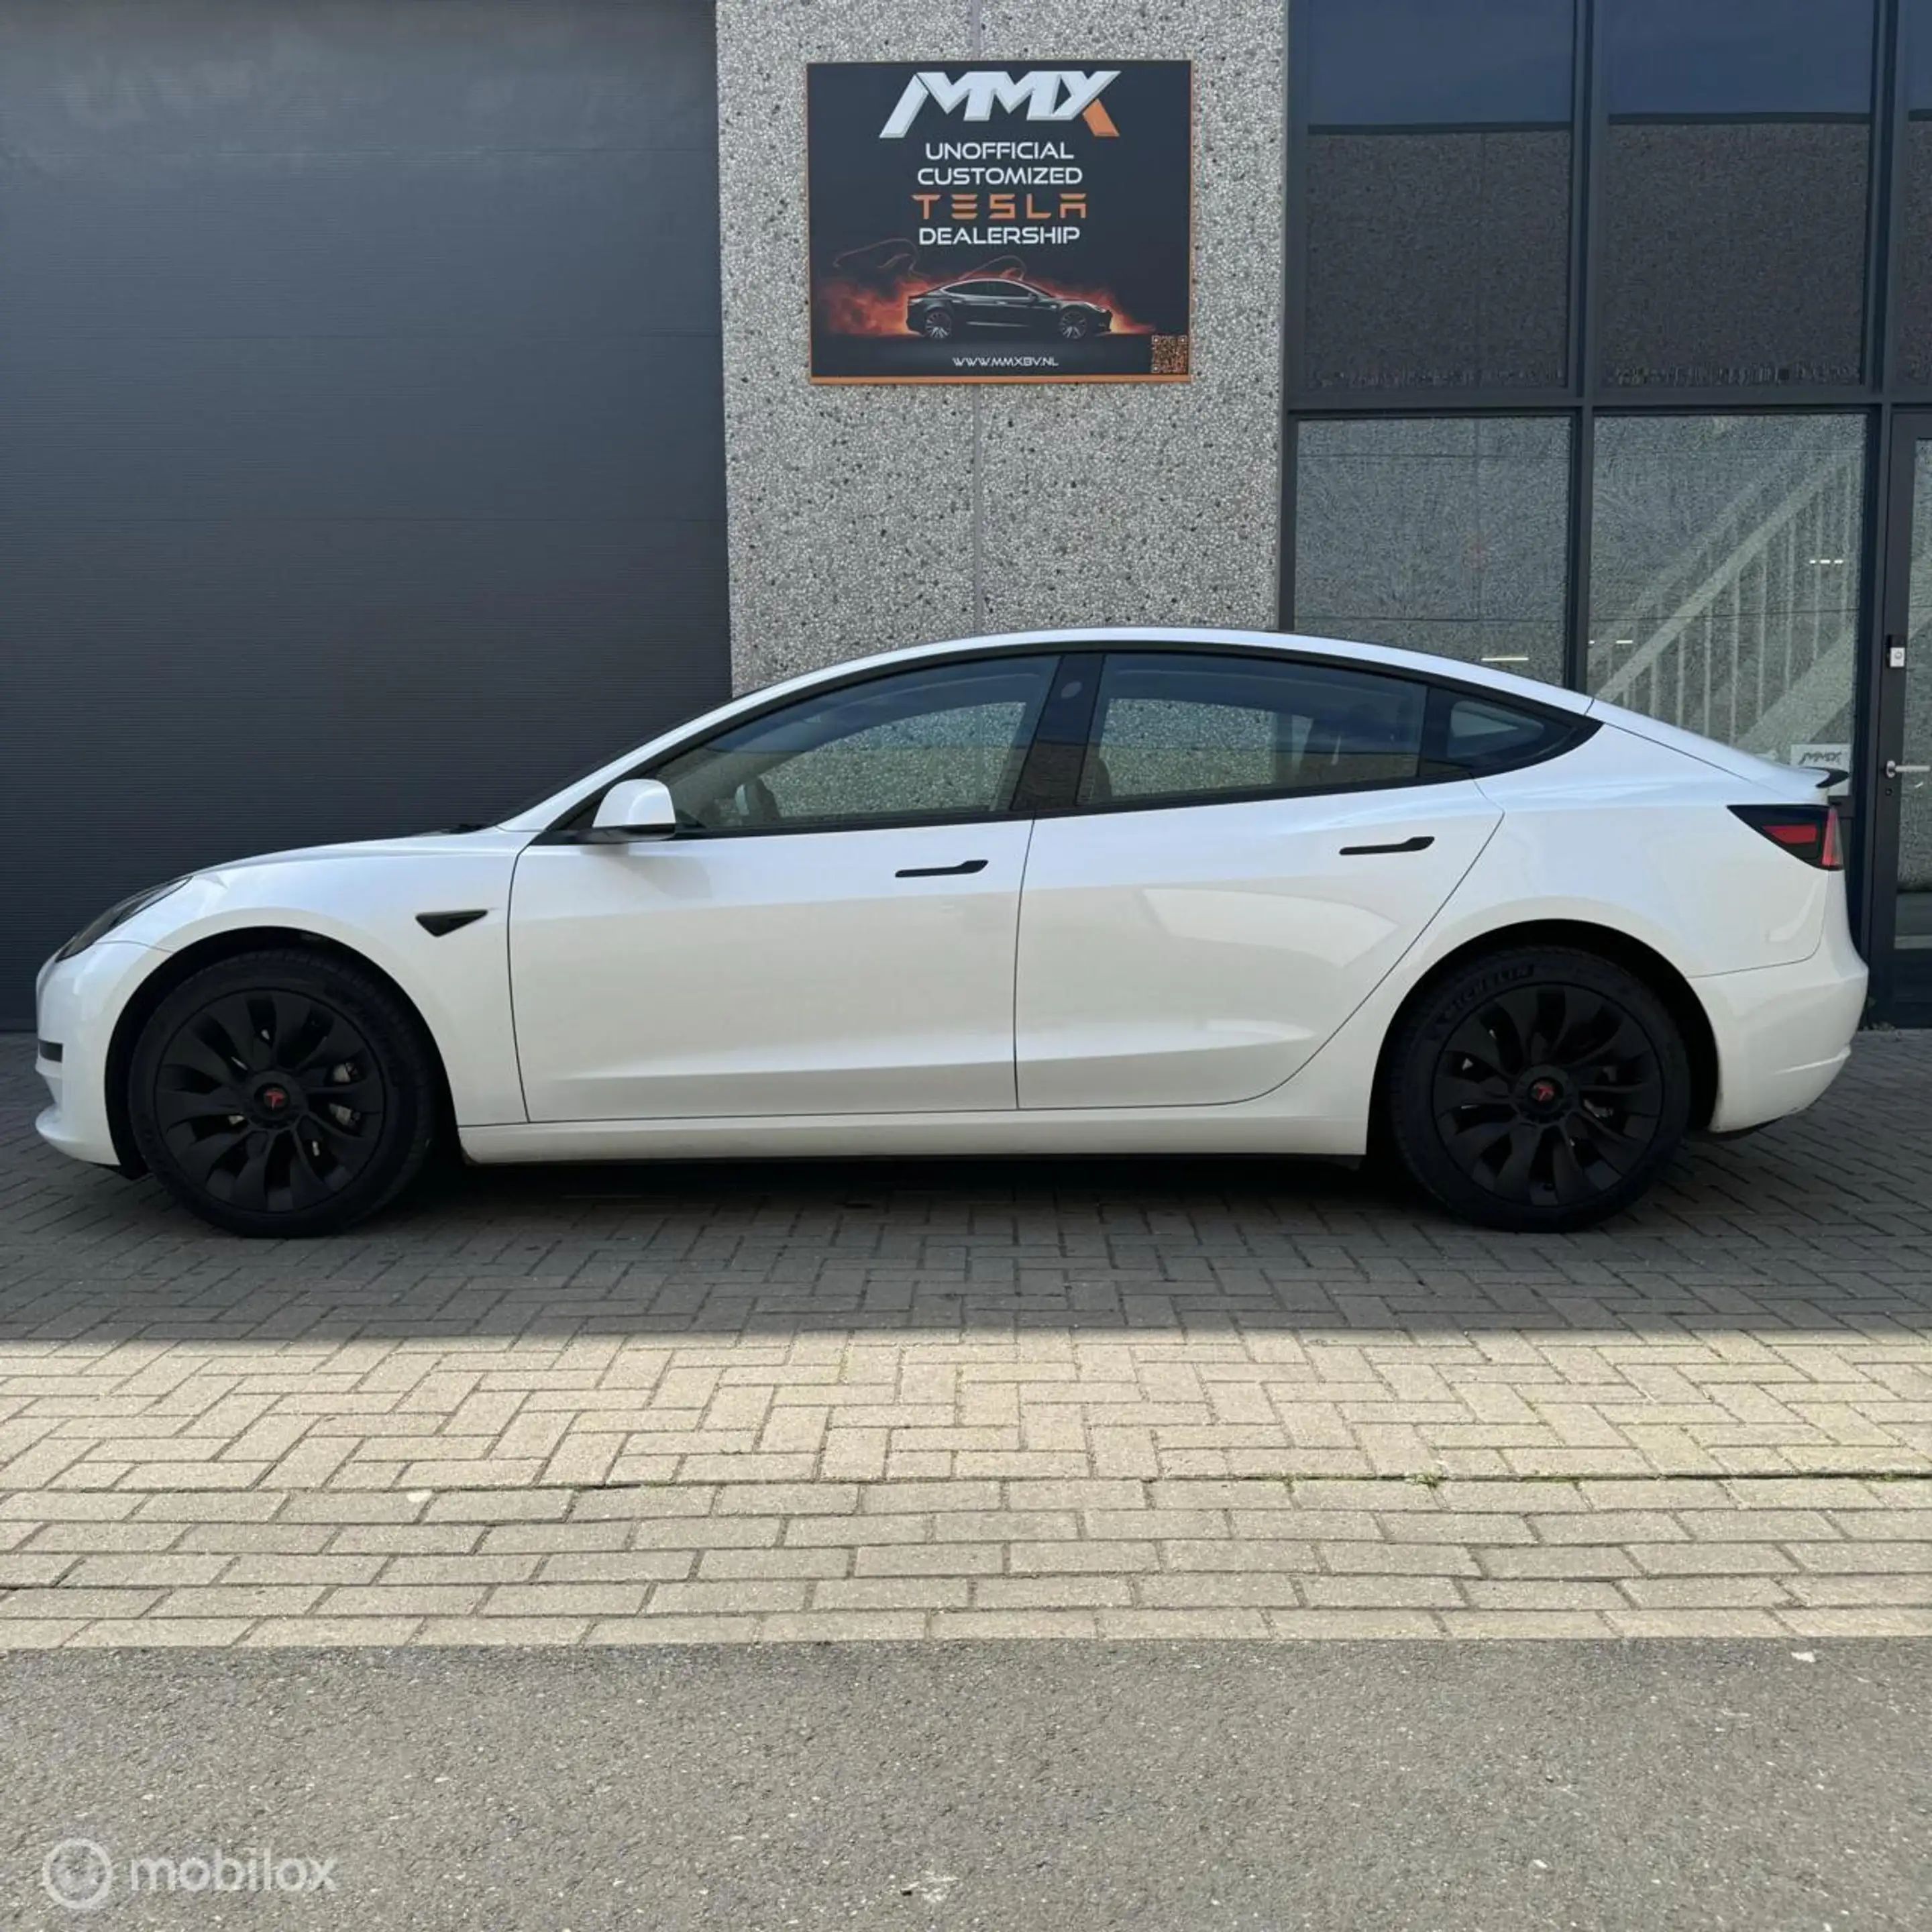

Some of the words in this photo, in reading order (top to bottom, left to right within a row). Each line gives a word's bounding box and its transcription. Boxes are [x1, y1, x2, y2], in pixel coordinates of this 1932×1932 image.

[879, 70, 1122, 139] MMX
[925, 142, 1075, 160] UNOFFICIAL
[917, 167, 1083, 185] CUSTOMIZED
[912, 193, 1087, 219] TESLA
[919, 226, 1081, 246] DEALERSHIP
[952, 356, 1059, 367] WWW.MMXBV.NL
